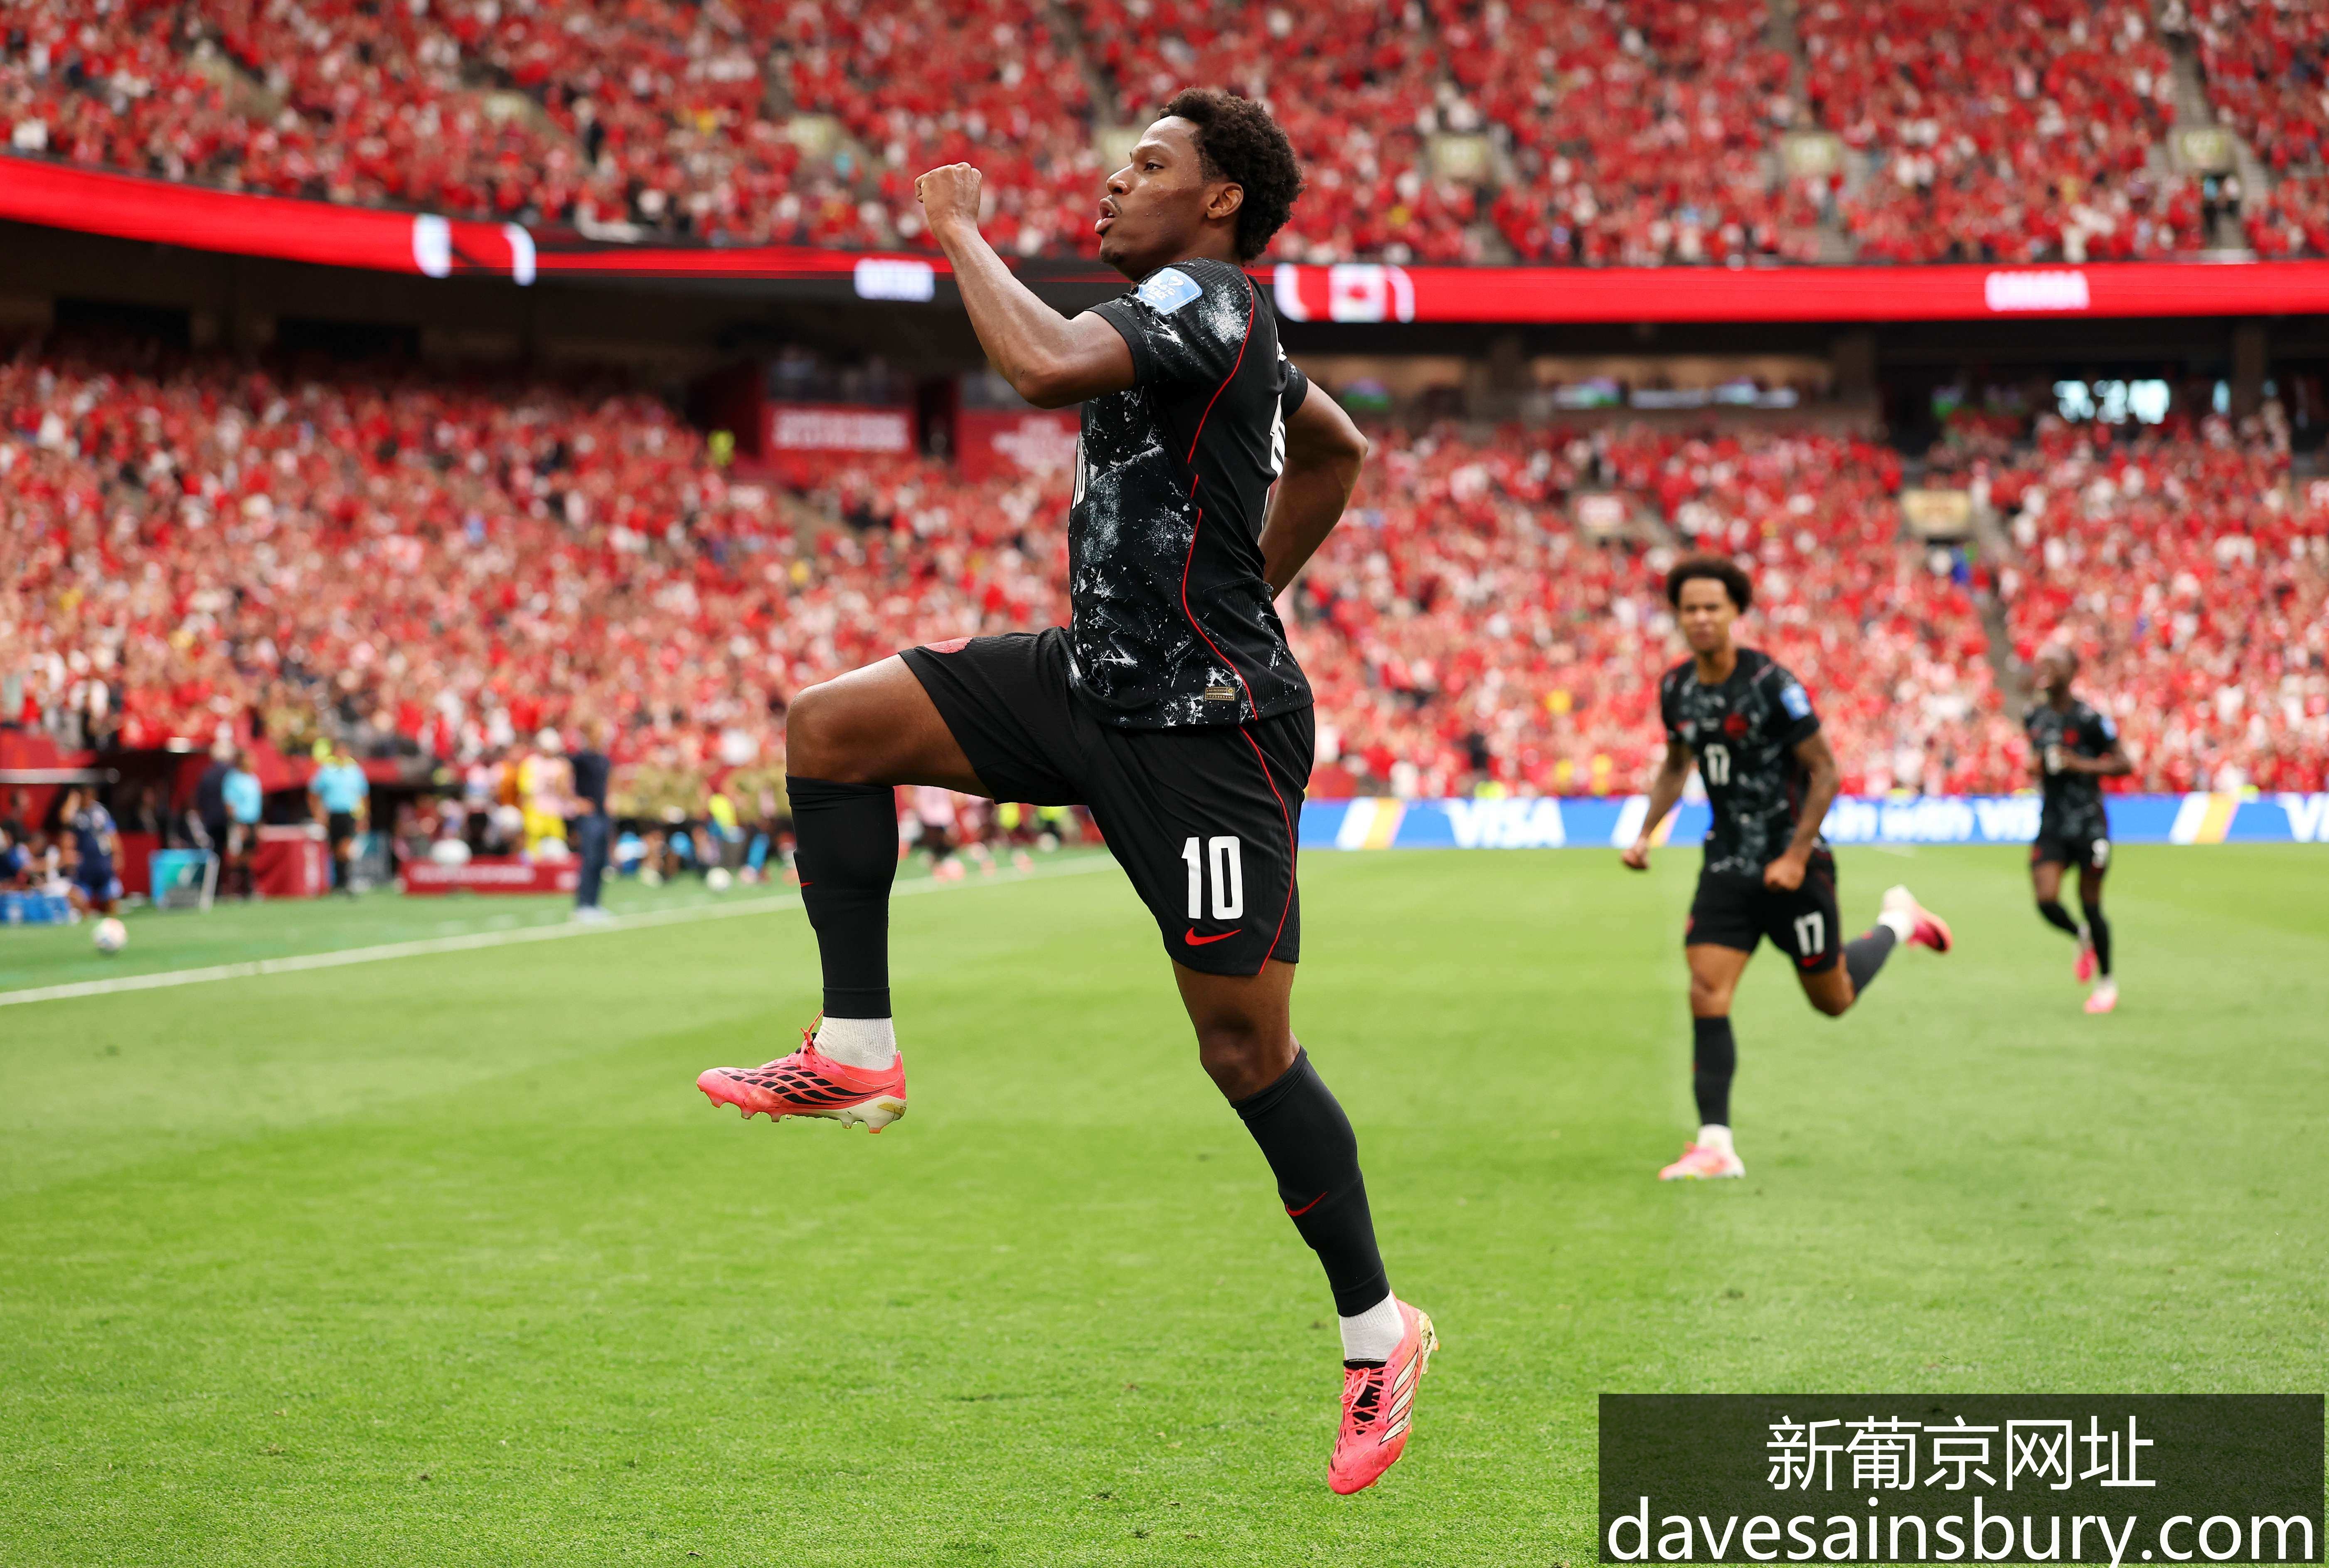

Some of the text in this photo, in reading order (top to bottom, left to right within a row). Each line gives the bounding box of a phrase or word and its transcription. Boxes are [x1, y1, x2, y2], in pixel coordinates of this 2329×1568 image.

[1704, 743, 1731, 786] 17
[1444, 797, 1566, 849] VISA
[1819, 795, 1879, 842] in
[1975, 797, 2042, 842] VIS
[1182, 836, 1243, 920] 10
[1793, 911, 1825, 956] 17
